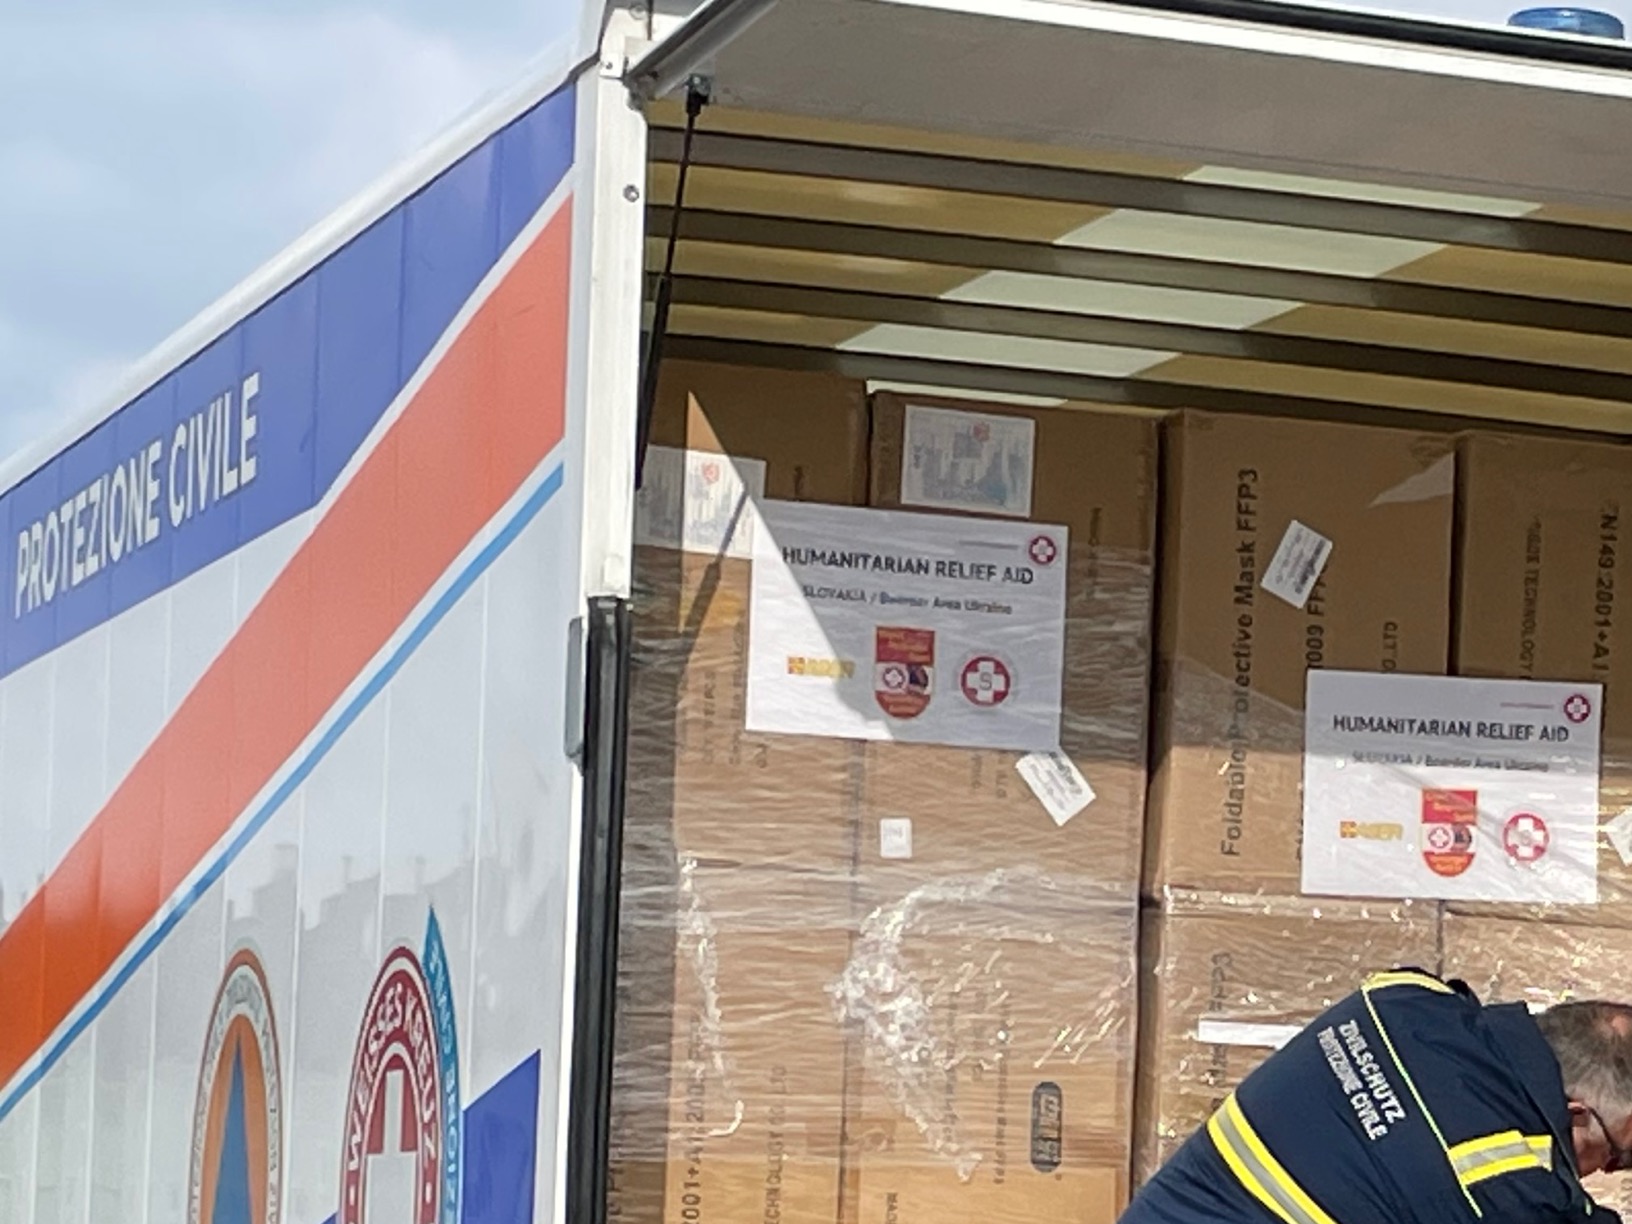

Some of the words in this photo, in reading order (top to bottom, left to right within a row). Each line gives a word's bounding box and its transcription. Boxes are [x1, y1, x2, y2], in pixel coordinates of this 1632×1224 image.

[14, 440, 163, 619] PROTEZIONE
[168, 372, 261, 529] CIVILE
[1235, 468, 1259, 533] FFP3
[782, 546, 929, 577] HUMANITARIAN
[935, 561, 997, 582] RELIEF
[1001, 567, 1034, 585] AID
[1233, 540, 1257, 607] Mask
[1226, 614, 1254, 740] Protective
[1332, 714, 1472, 738] HUMANITARIAN
[1476, 722, 1535, 742] RELIEF
[1539, 726, 1570, 742] AID
[1220, 749, 1250, 857] Foldable
